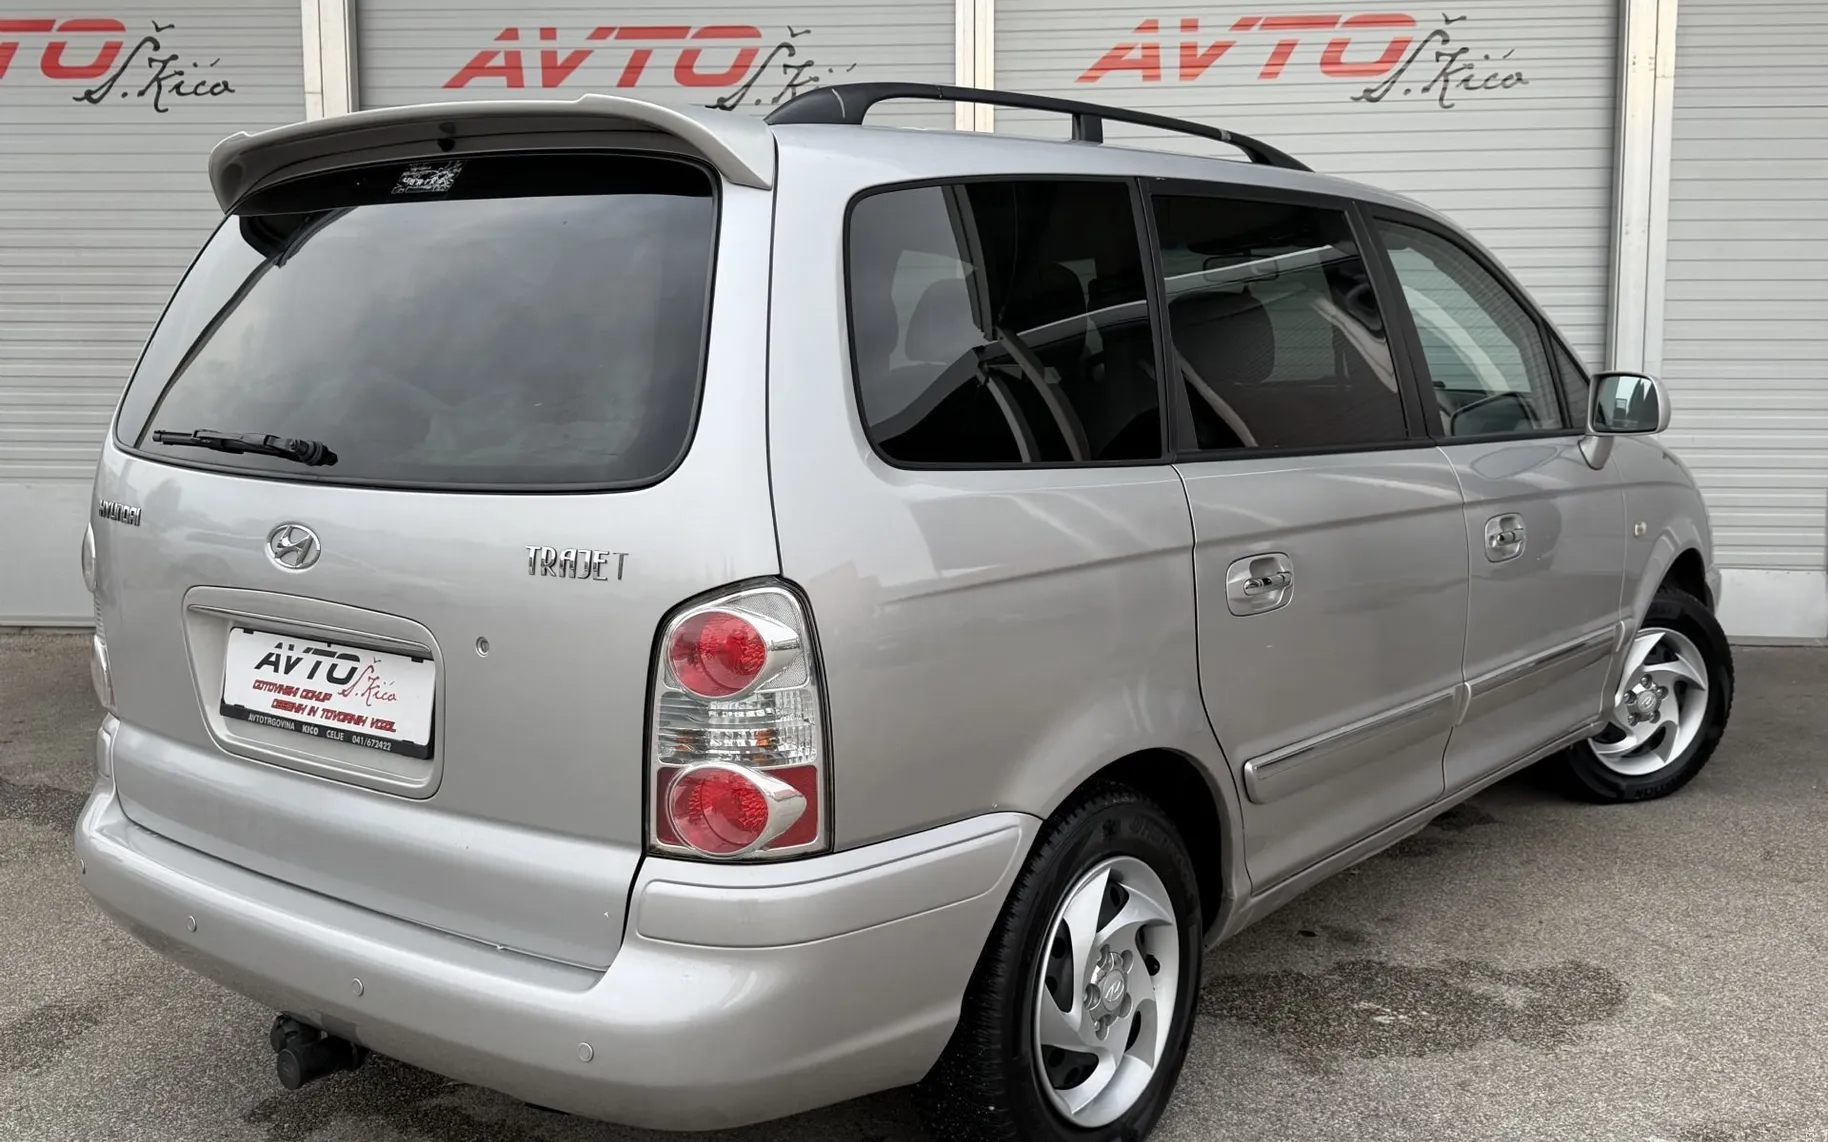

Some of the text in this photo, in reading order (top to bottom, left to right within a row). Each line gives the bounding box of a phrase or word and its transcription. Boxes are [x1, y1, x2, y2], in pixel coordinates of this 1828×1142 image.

[441, 25, 762, 89] AVTO
[1074, 13, 1416, 83] AVTO
[99, 499, 142, 527] HYUNDAI
[525, 544, 629, 581] TRAJET
[254, 642, 360, 686] AVTO
[248, 713, 295, 731] AVTOTRGOVINA
[326, 730, 344, 741] CELJE
[352, 735, 392, 751] 041/672422
[307, 705, 319, 717] IN
[320, 708, 368, 727] TOVORNIH
